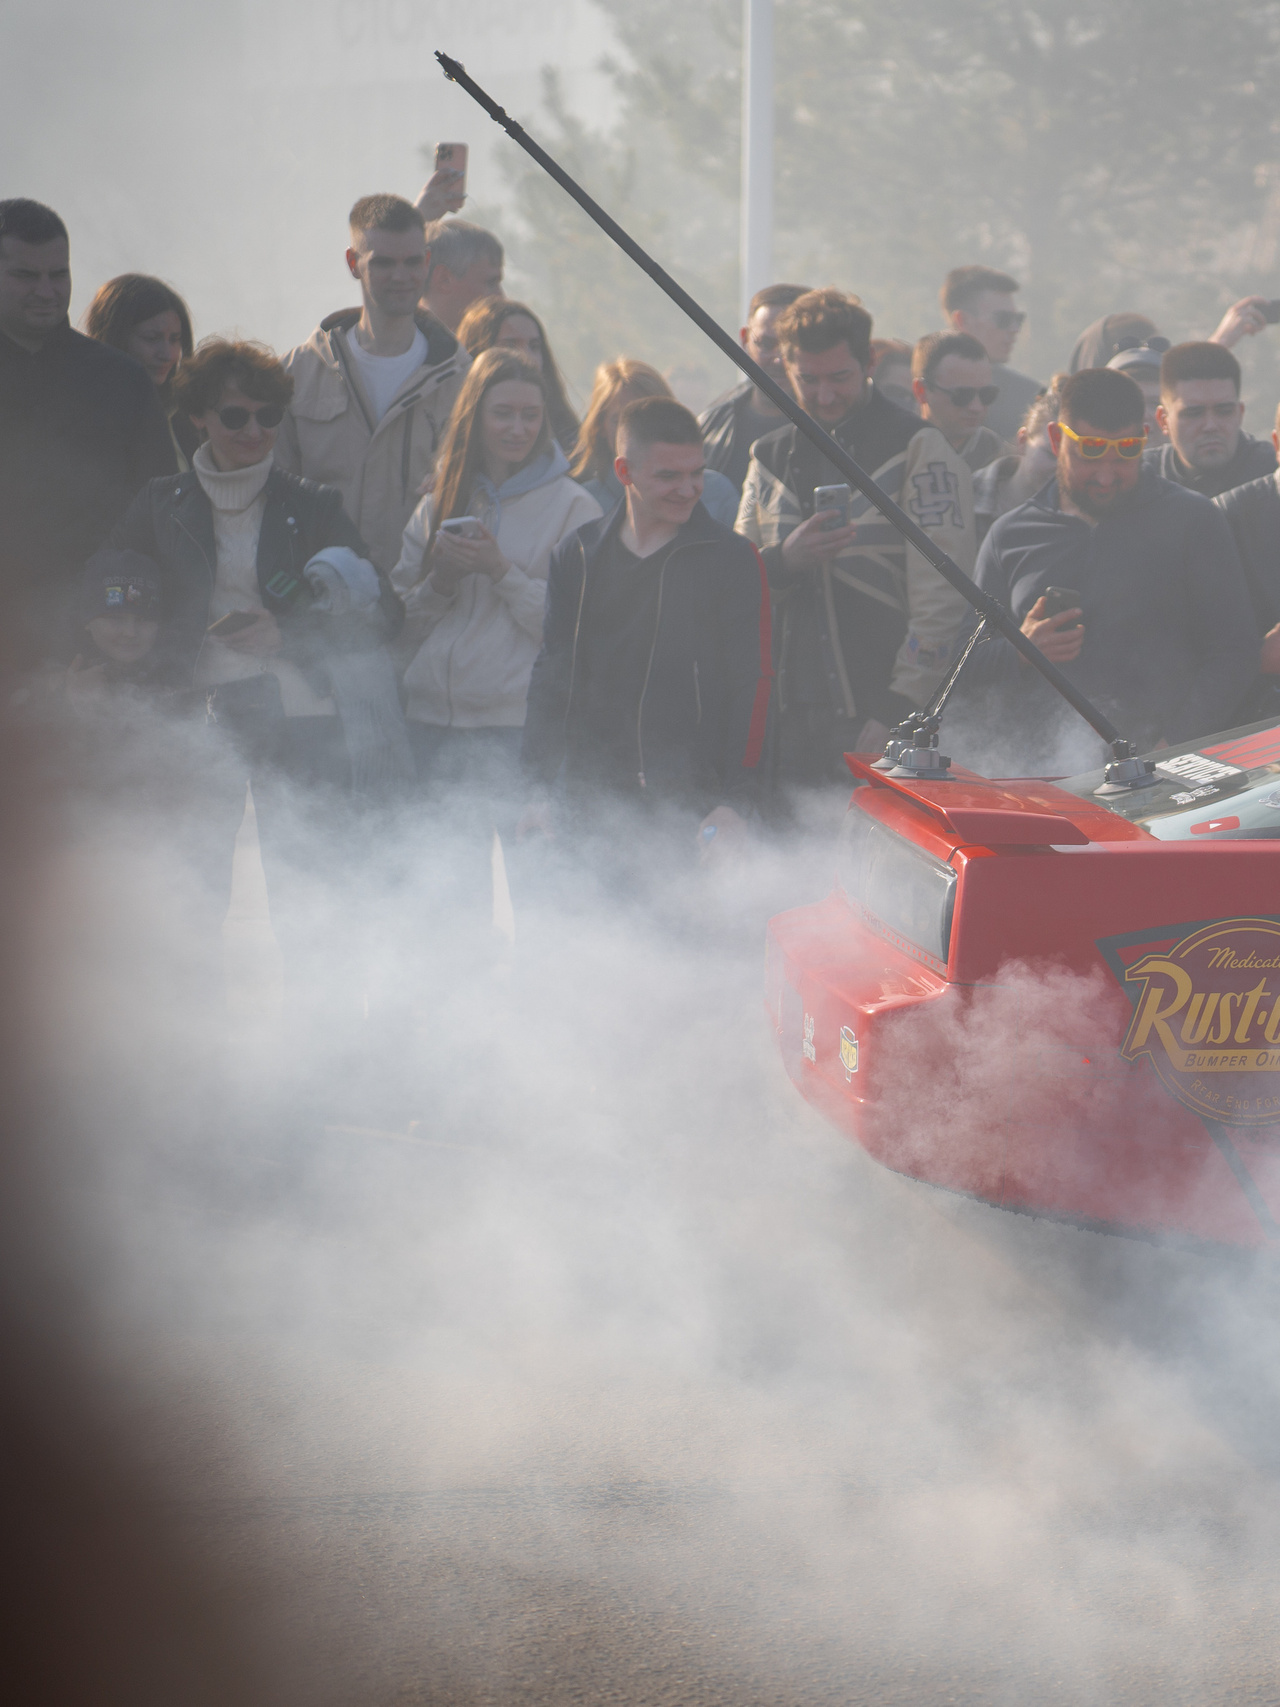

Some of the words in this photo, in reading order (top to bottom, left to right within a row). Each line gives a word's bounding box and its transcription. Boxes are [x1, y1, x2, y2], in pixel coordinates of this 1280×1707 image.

[1155, 753, 1243, 784] SERVICE
[1184, 1053, 1248, 1067] BUMPER
[1226, 1095, 1250, 1110] END
